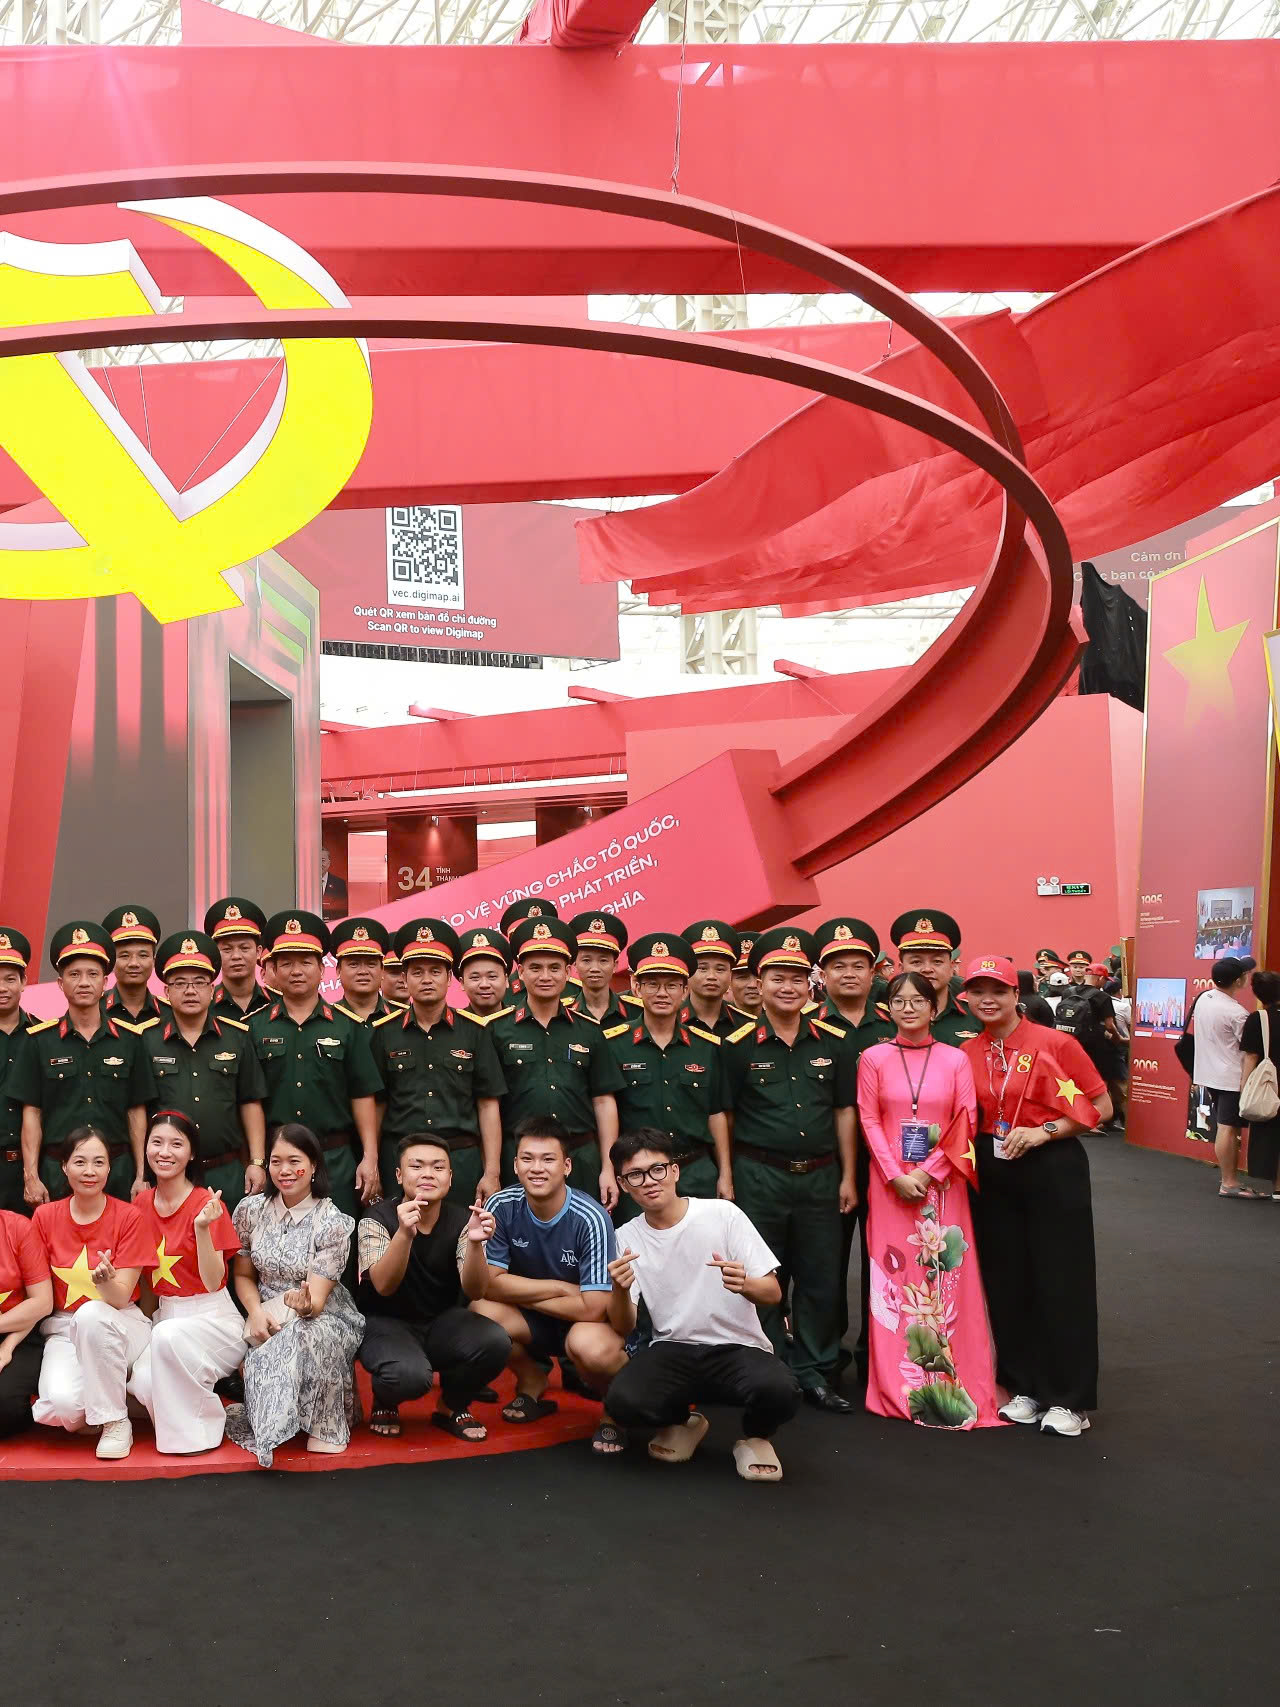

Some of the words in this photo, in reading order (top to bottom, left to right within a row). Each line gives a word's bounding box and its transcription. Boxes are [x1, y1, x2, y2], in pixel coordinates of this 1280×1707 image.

[1130, 552, 1160, 562] Cảm
[1111, 571, 1136, 582] bạn
[392, 589, 460, 602] vec.digimap.ai
[353, 605, 378, 617] Quét
[379, 608, 394, 619] QR
[395, 610, 416, 620] xem
[417, 610, 436, 621] bản
[367, 621, 392, 632] Scan
[393, 623, 408, 634] QR
[410, 624, 419, 634] to
[421, 625, 444, 636] view
[445, 626, 484, 640] Digimap
[465, 901, 491, 920] VỆ
[545, 857, 597, 888] CHẮC
[598, 838, 622, 862] TỔ
[623, 814, 680, 850] QUỐC,
[397, 866, 433, 891] 34
[558, 879, 602, 908] PHÁT
[604, 853, 658, 886] TRIỂN,
